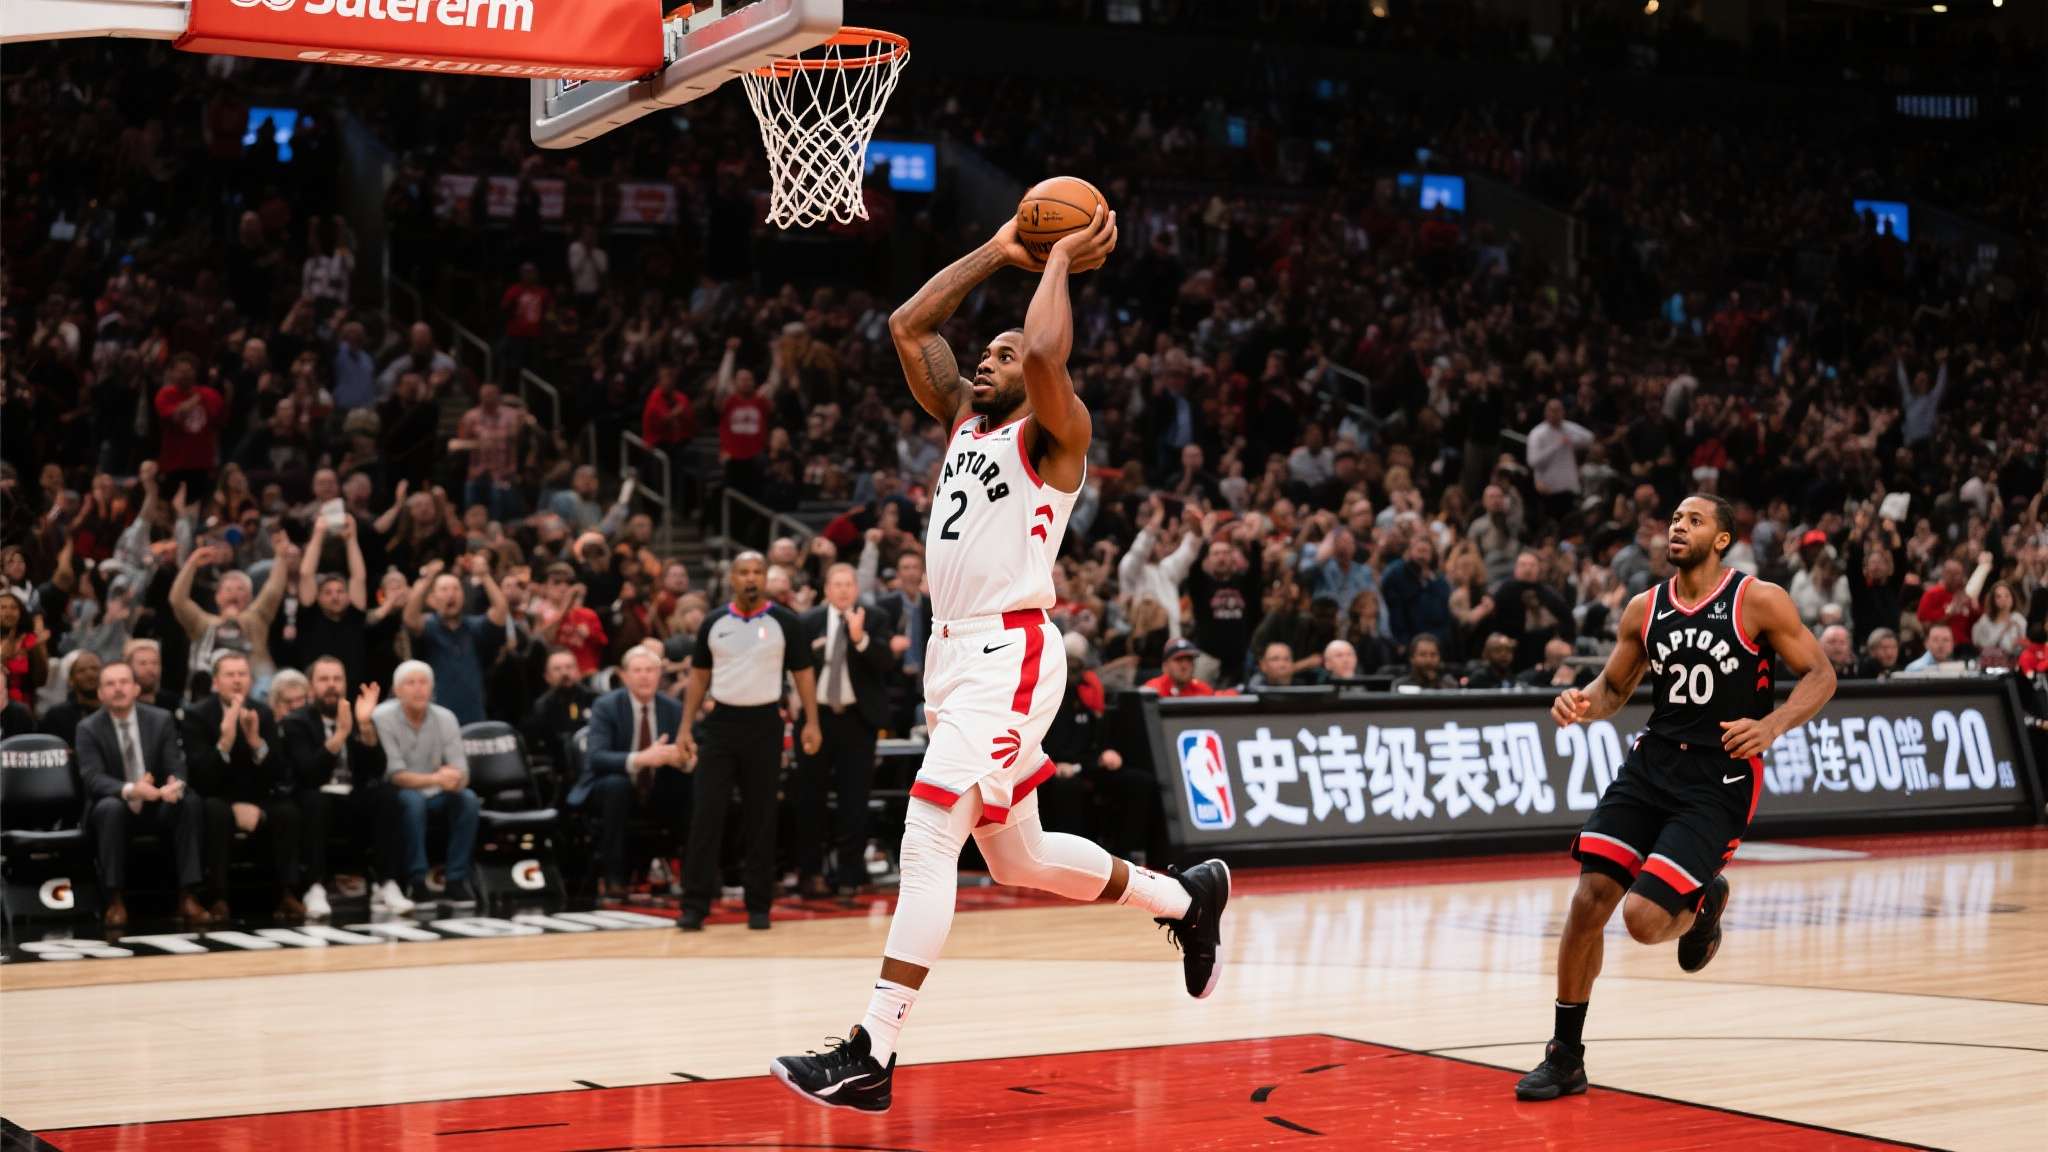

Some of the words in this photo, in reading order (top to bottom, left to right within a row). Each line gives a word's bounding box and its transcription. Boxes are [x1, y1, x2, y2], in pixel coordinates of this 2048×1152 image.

[936, 451, 1010, 503] APTORS
[940, 490, 968, 540] 2
[1668, 664, 1714, 705] 20
[39, 878, 75, 910] G
[511, 859, 546, 890] G
